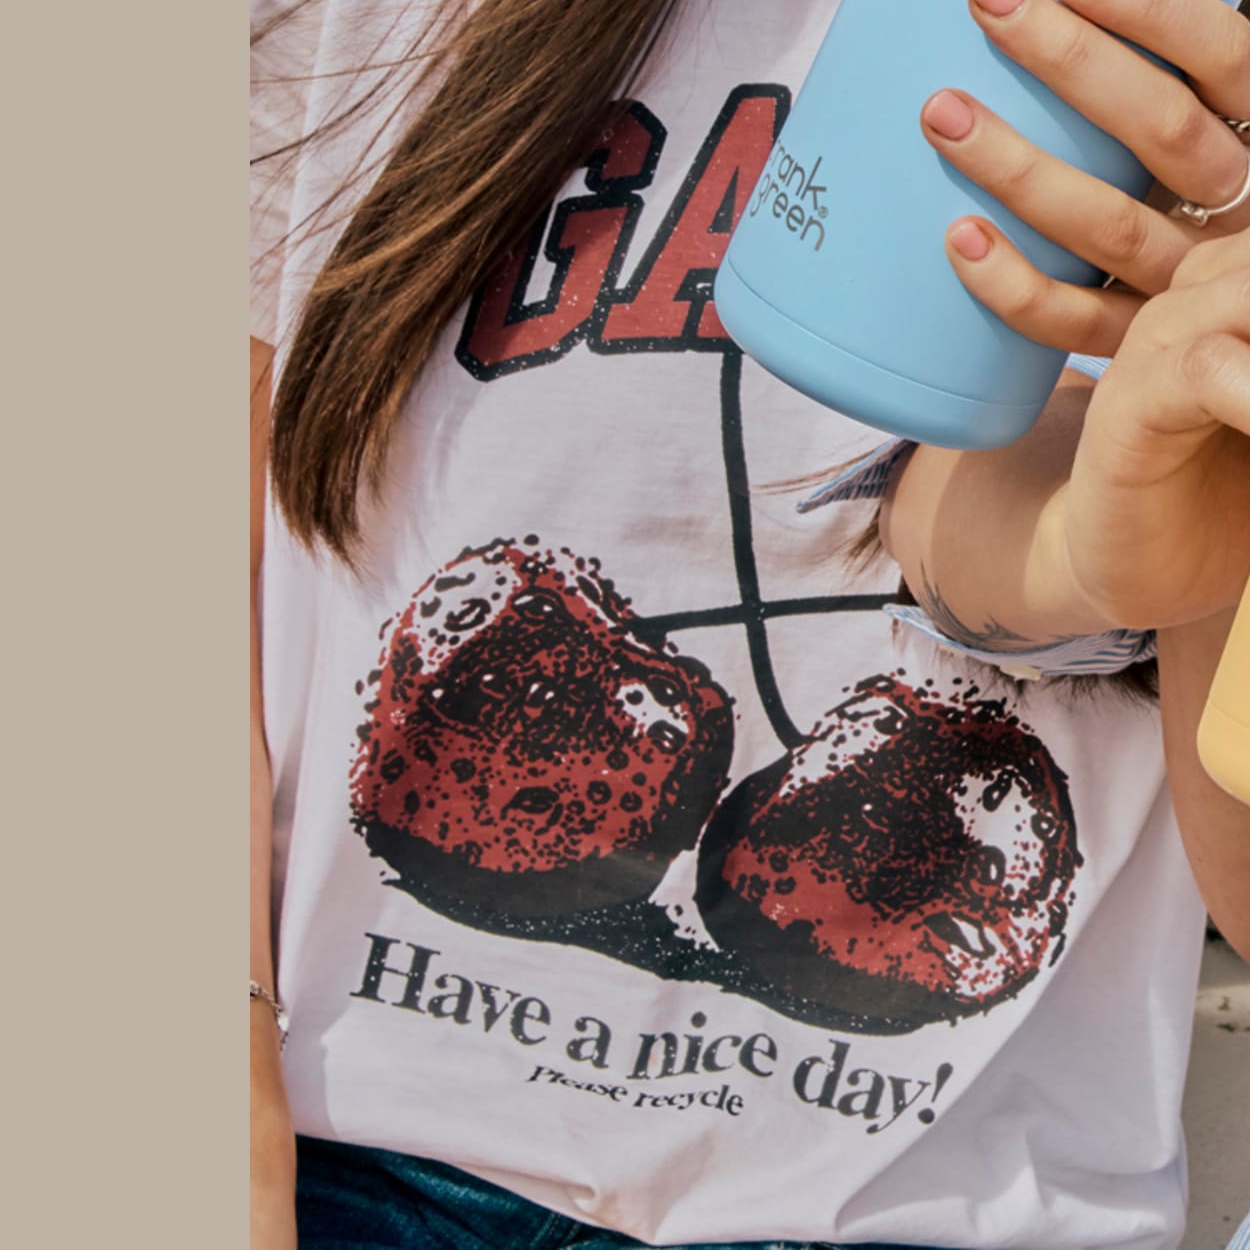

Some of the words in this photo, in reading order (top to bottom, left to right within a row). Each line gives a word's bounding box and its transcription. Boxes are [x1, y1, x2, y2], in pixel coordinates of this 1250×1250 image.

[750, 173, 825, 252] green
[349, 932, 551, 1045] Have
[565, 1015, 610, 1069] a
[626, 1011, 778, 1081] nice
[793, 1038, 954, 1135] day!
[633, 1084, 744, 1116] recycle
